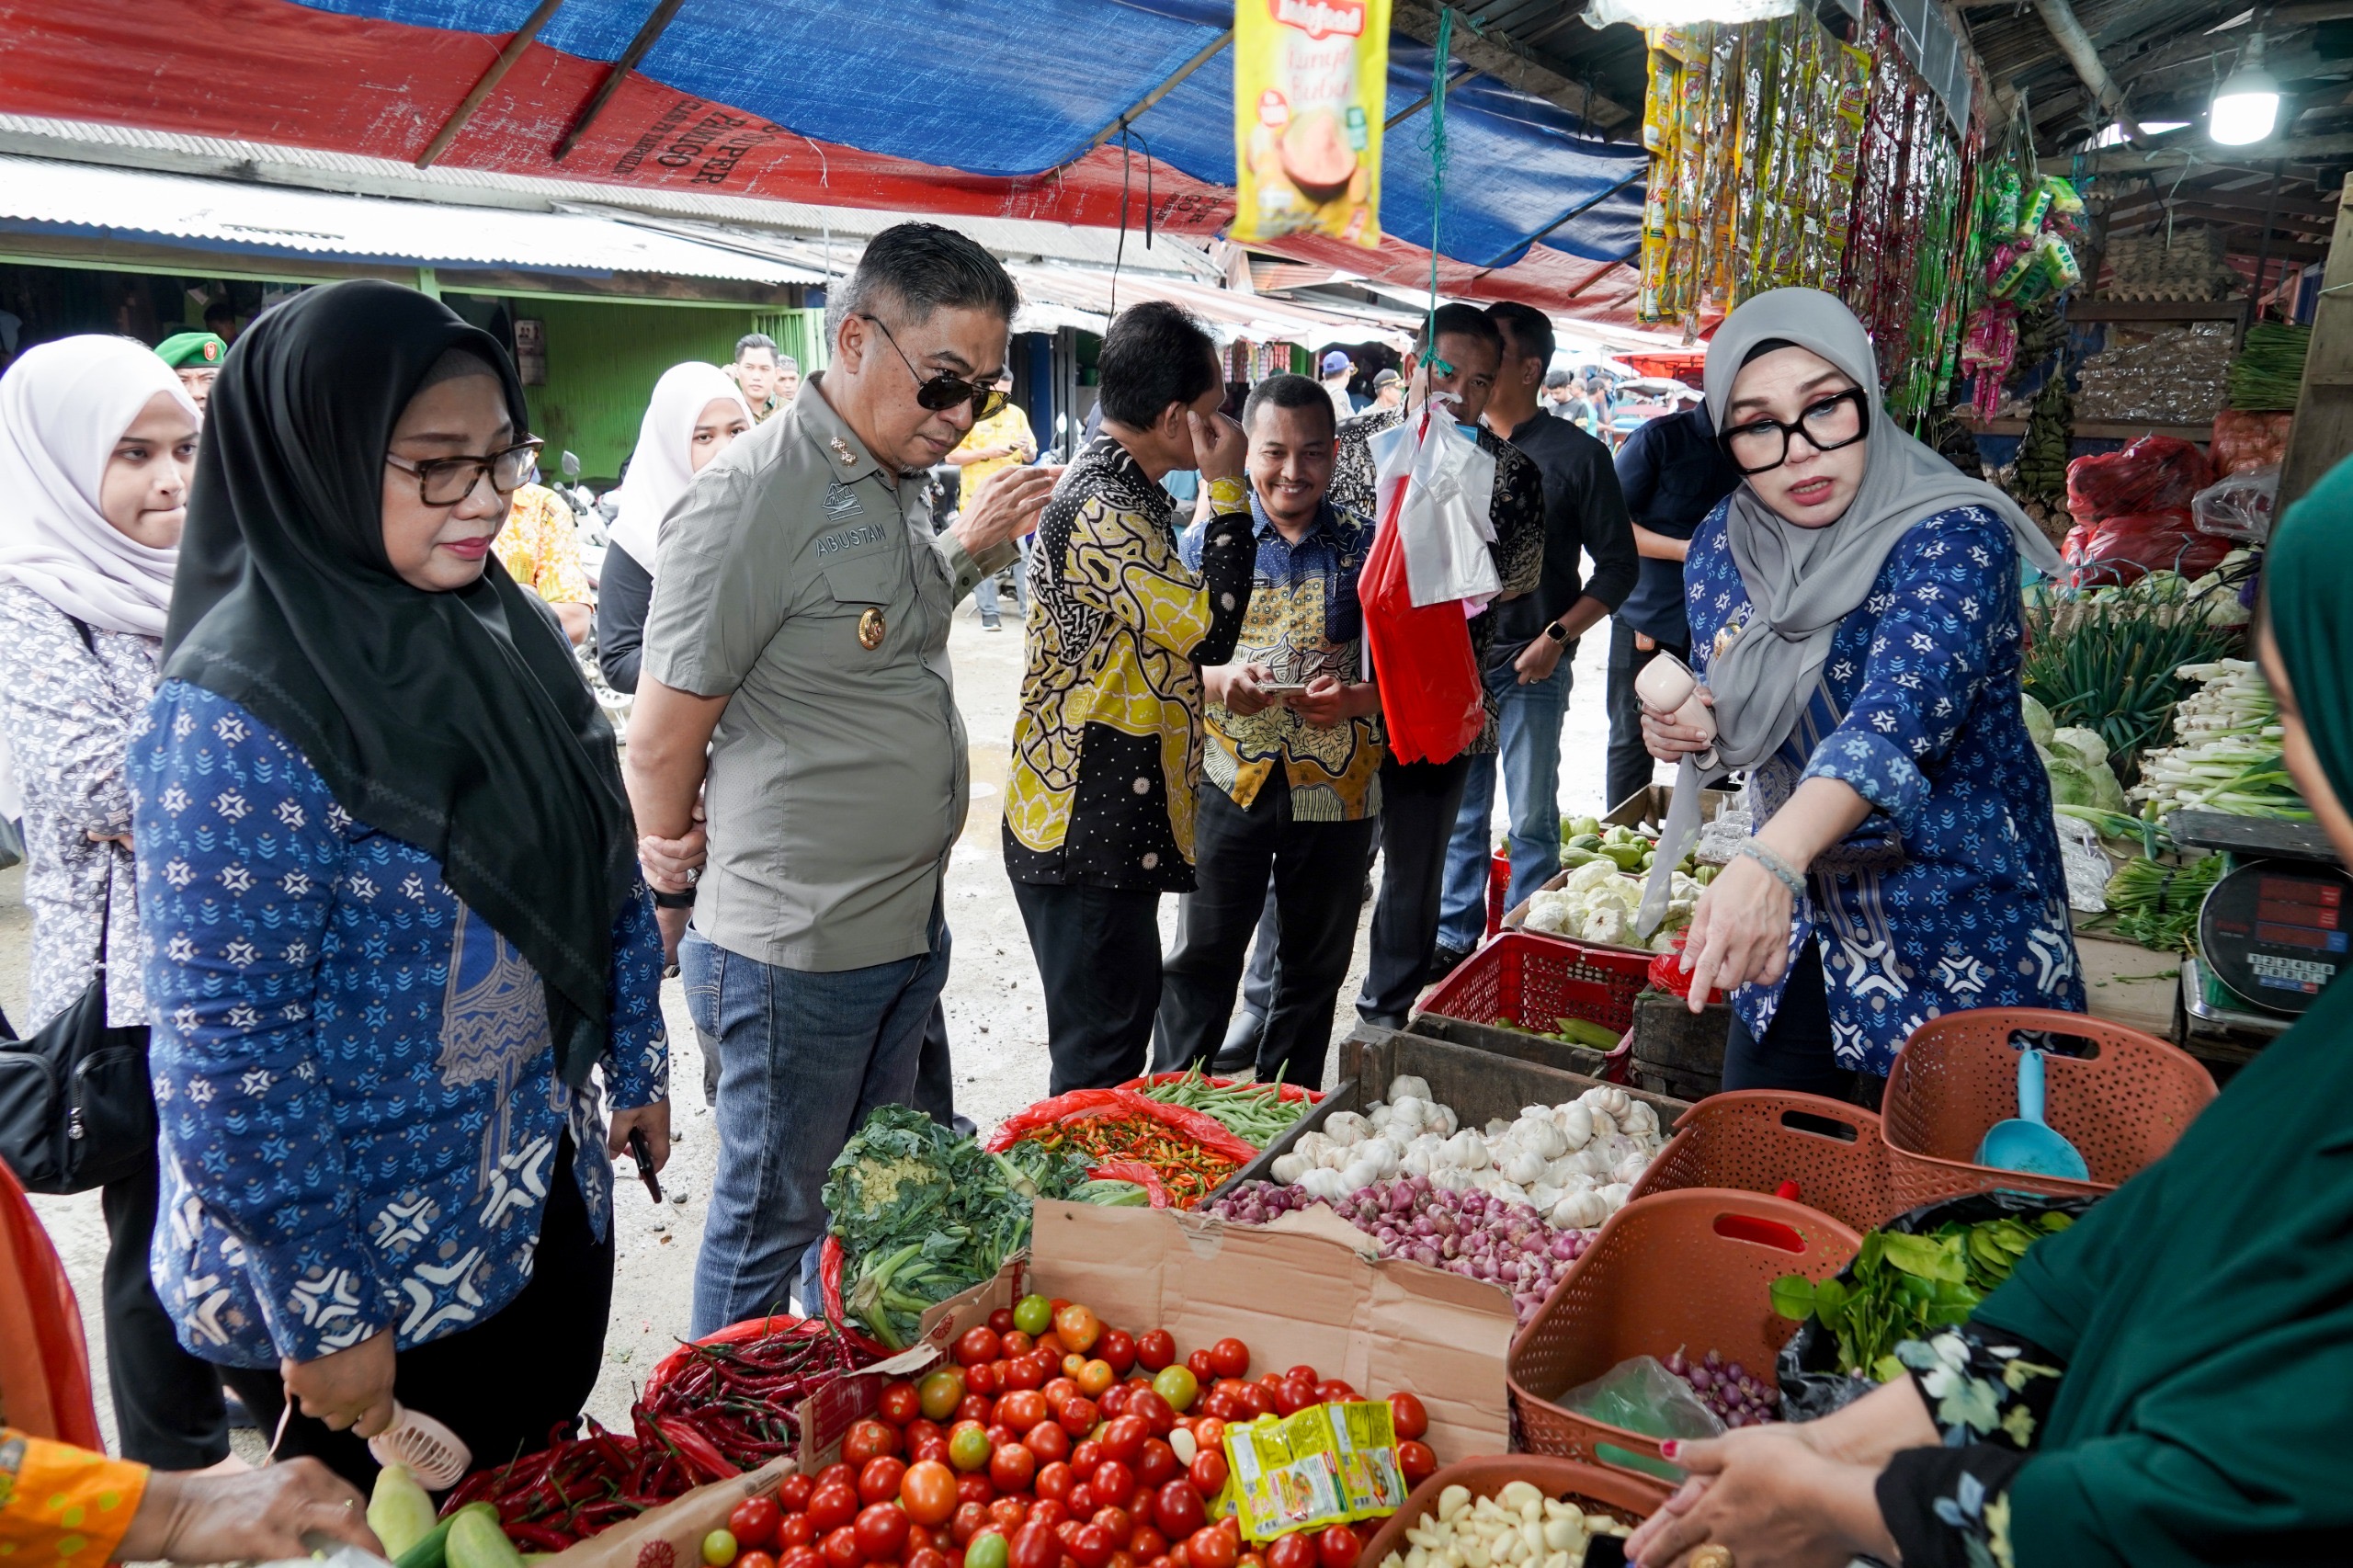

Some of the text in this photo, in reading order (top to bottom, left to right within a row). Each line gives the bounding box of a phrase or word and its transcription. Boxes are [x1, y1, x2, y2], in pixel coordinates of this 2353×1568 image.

[814, 523, 887, 558] ABUSTAN
[2251, 955, 2257, 963] 1
[2266, 957, 2273, 965] 2
[2279, 959, 2287, 967] 3
[2294, 960, 2302, 969] 4
[2309, 962, 2316, 971] 5
[2257, 966, 2265, 974] 7
